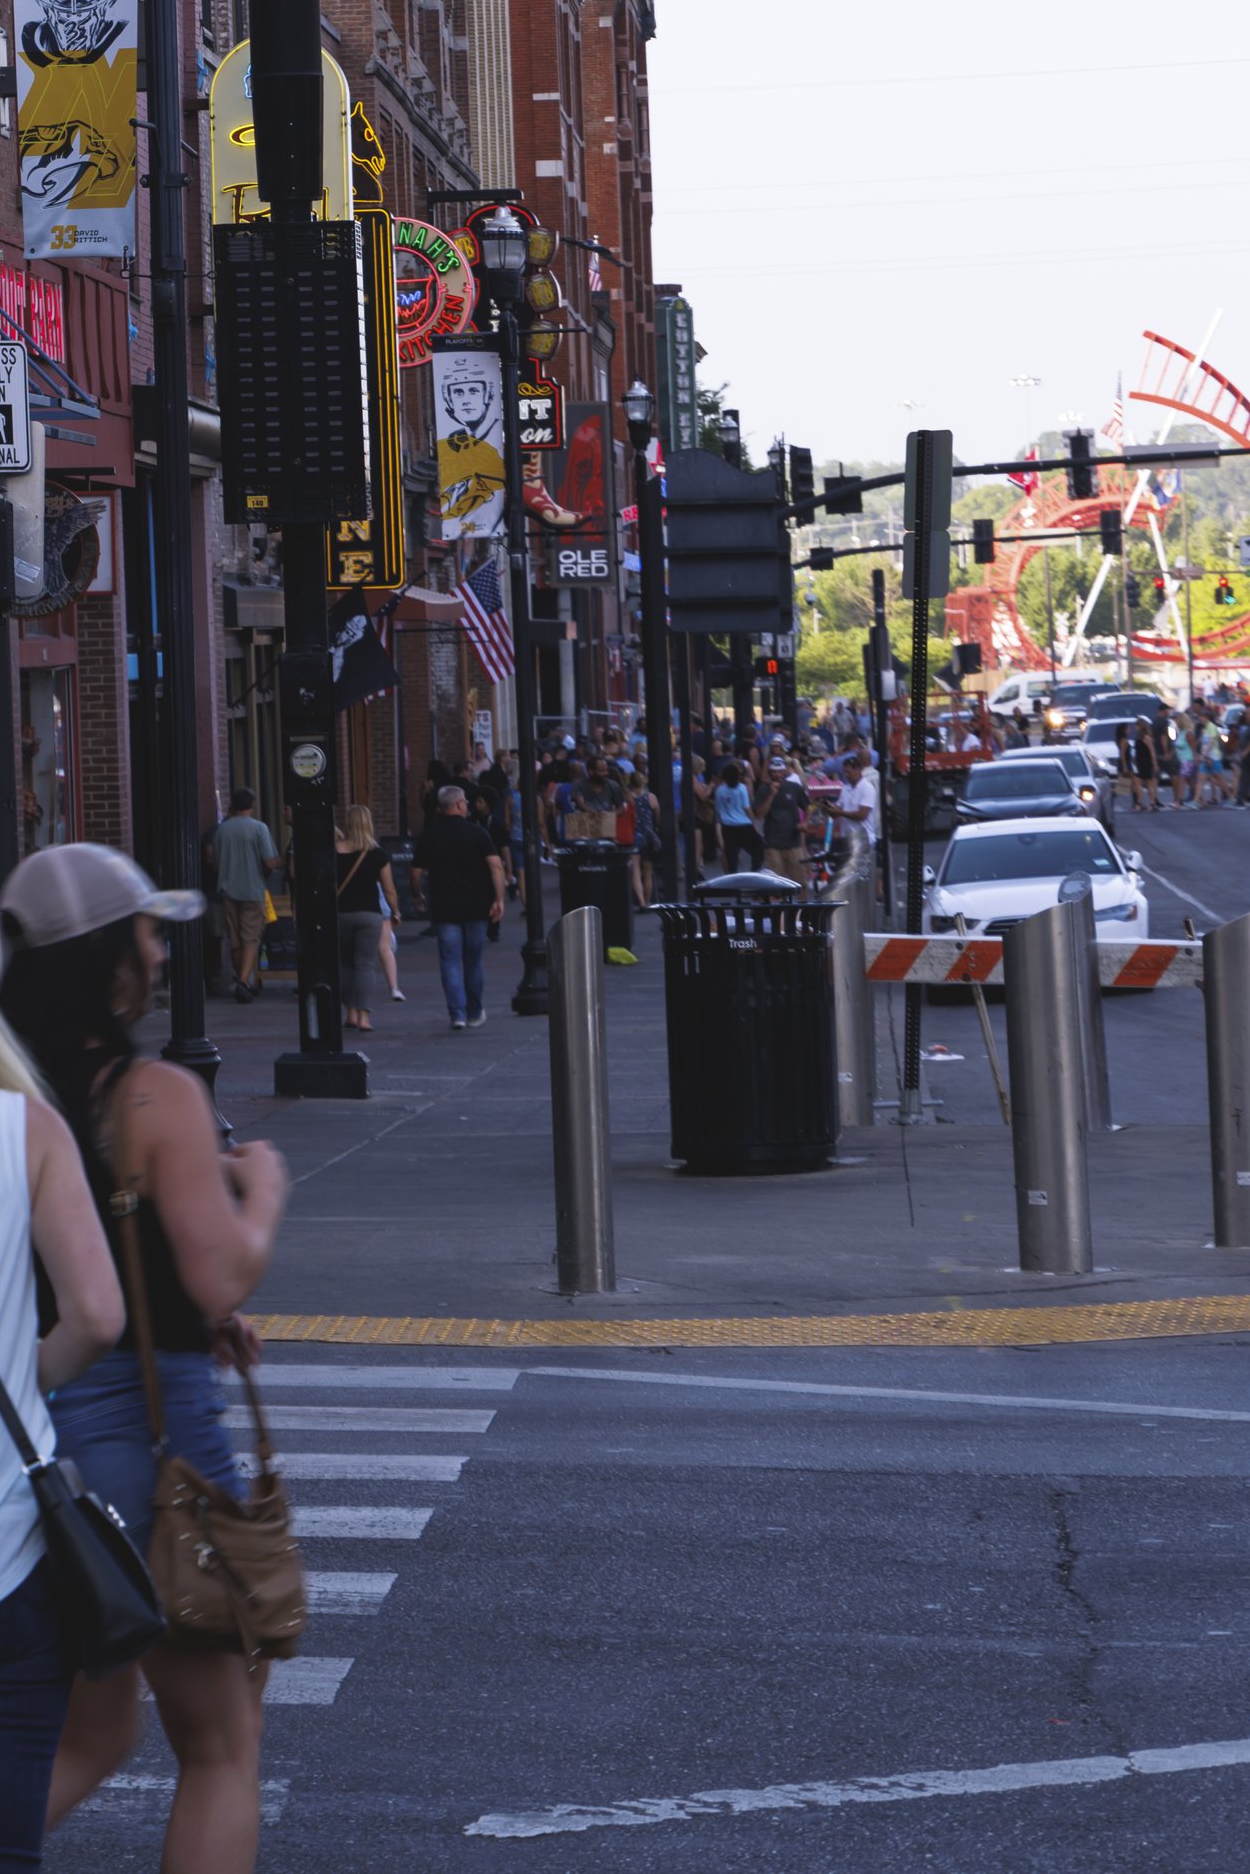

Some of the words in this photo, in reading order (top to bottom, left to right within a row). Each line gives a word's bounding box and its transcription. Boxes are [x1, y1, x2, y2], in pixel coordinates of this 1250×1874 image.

[50, 224, 78, 250] 33
[74, 229, 99, 237] DAVID
[74, 236, 108, 244] RITTICH
[399, 222, 461, 273] NAH'S
[398, 293, 465, 362] KITCHEN
[558, 549, 608, 564] OLE
[559, 563, 610, 578] RED
[728, 938, 758, 949] Trash
